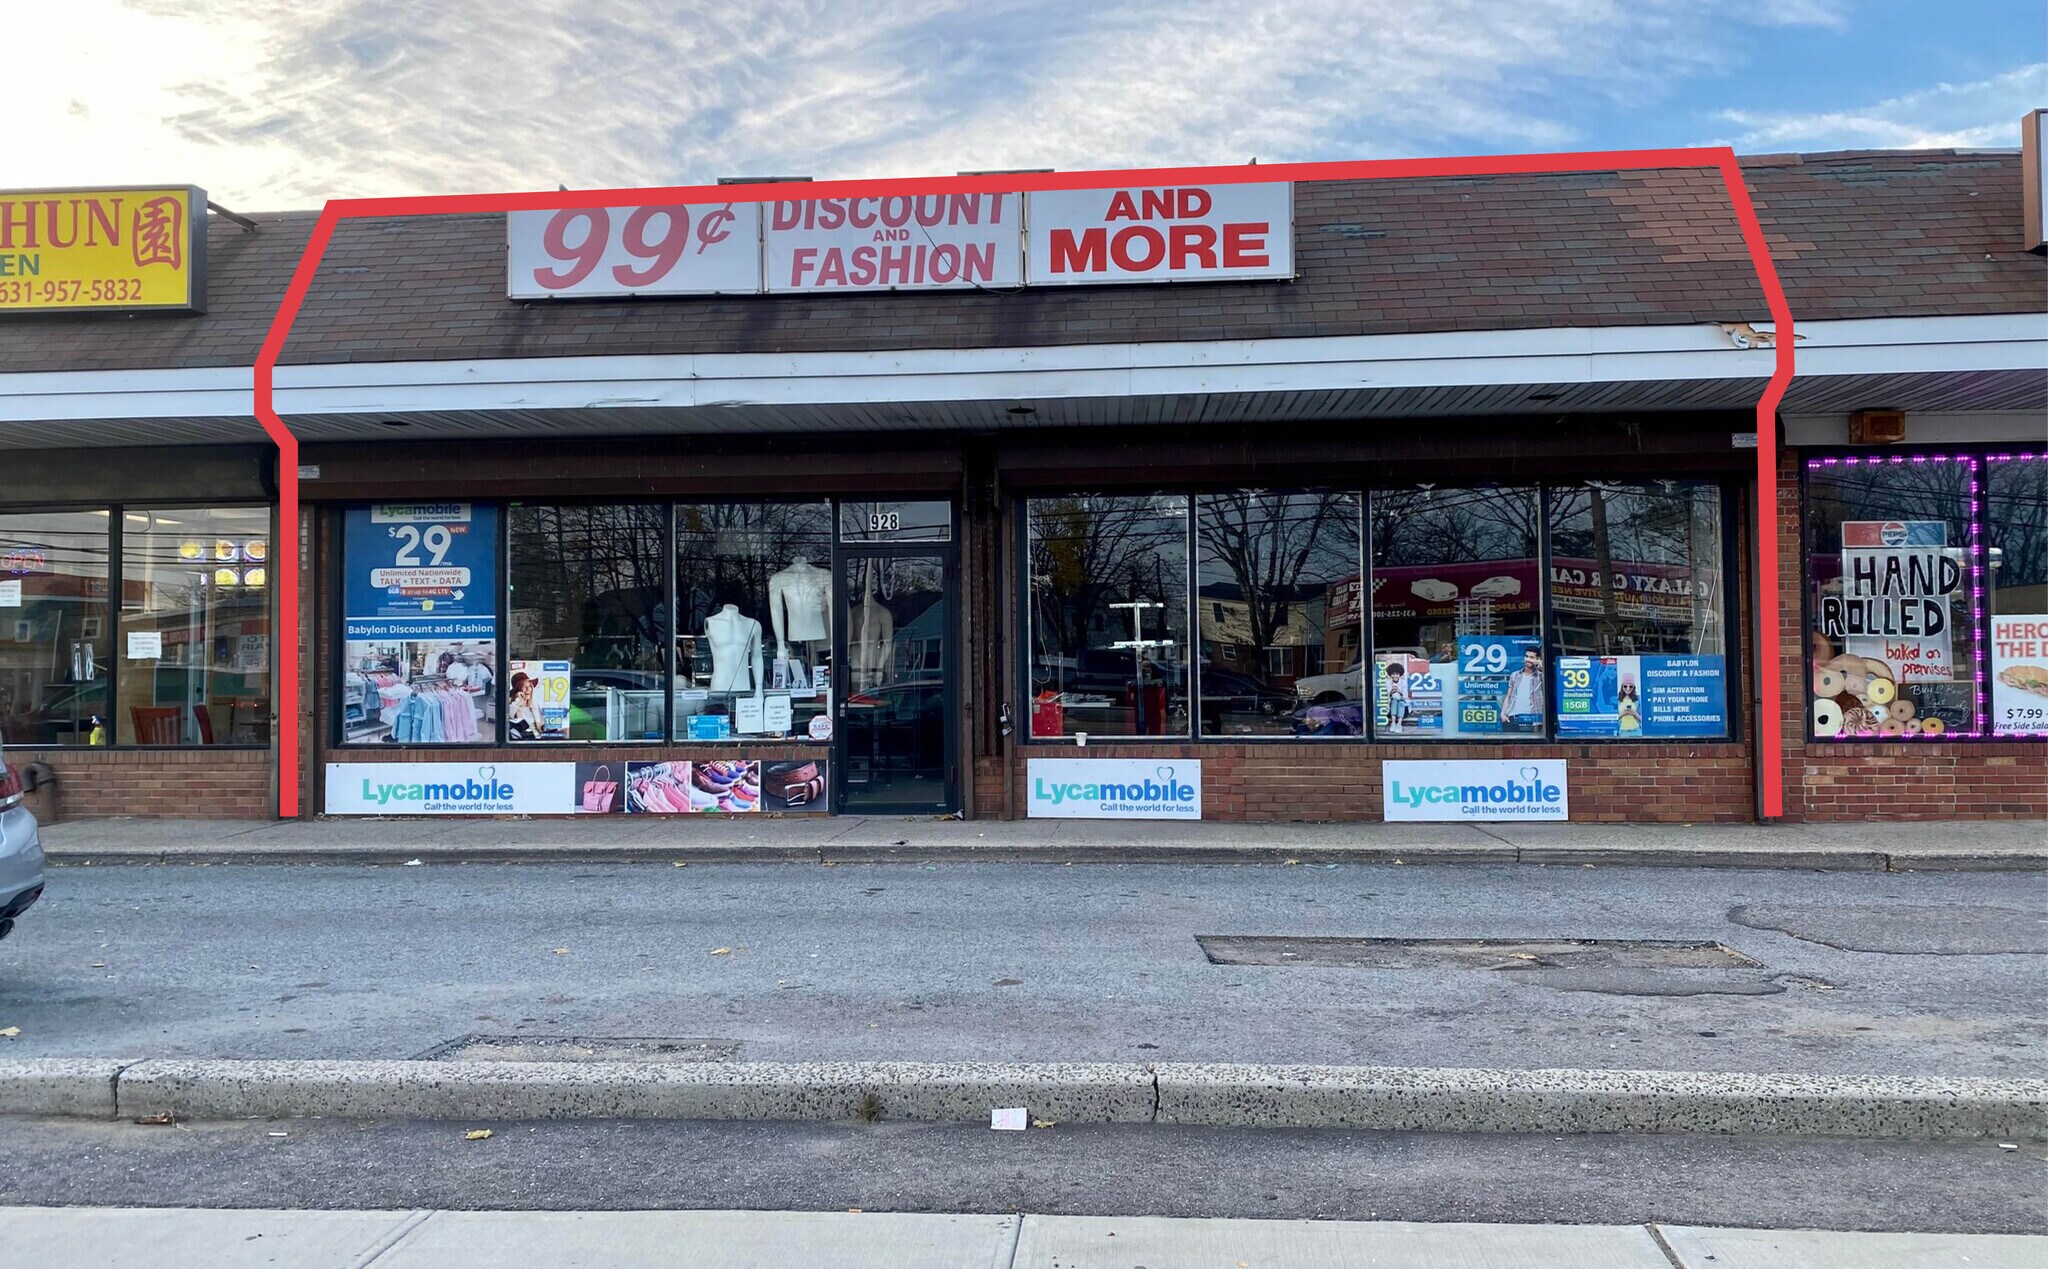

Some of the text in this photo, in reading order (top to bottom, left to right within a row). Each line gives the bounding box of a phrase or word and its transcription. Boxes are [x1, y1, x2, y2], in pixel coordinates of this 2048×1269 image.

[772, 192, 1012, 230] DISCOUNT
[1105, 188, 1212, 221] AND
[0, 198, 123, 248] HUN
[873, 229, 910, 242] AND
[1050, 222, 1269, 273] MORE
[0, 254, 39, 276] EN
[791, 243, 996, 287] FASHION
[0, 279, 142, 303] 631-957-5832
[380, 504, 461, 517] Lycamobile
[871, 513, 899, 530] 928
[1882, 530, 1908, 538] PEPSI
[2, 554, 45, 568] OPEN
[1853, 554, 1961, 597] HAND
[1822, 597, 1945, 638] ROLLED
[348, 624, 493, 635] Babylon Discount and Fashion
[1885, 640, 1941, 660] baked on
[1997, 642, 2036, 657] THE
[1409, 672, 1436, 690] 23
[1901, 663, 1952, 684] premises
[543, 676, 569, 702] 19
[1377, 661, 1389, 726] Unlimited
[1910, 685, 1933, 699] Buy
[1465, 710, 1496, 722] 6GB
[1994, 721, 2012, 729] Free
[2013, 721, 2030, 729] Side
[363, 778, 514, 805] Lycamobile
[1036, 778, 1194, 804] Lycamobile
[1392, 780, 1560, 808] Lycamobile
[424, 803, 513, 811] Call the world for less
[1100, 803, 1194, 813] Call the world for less
[1462, 806, 1560, 814] Call the world for less
